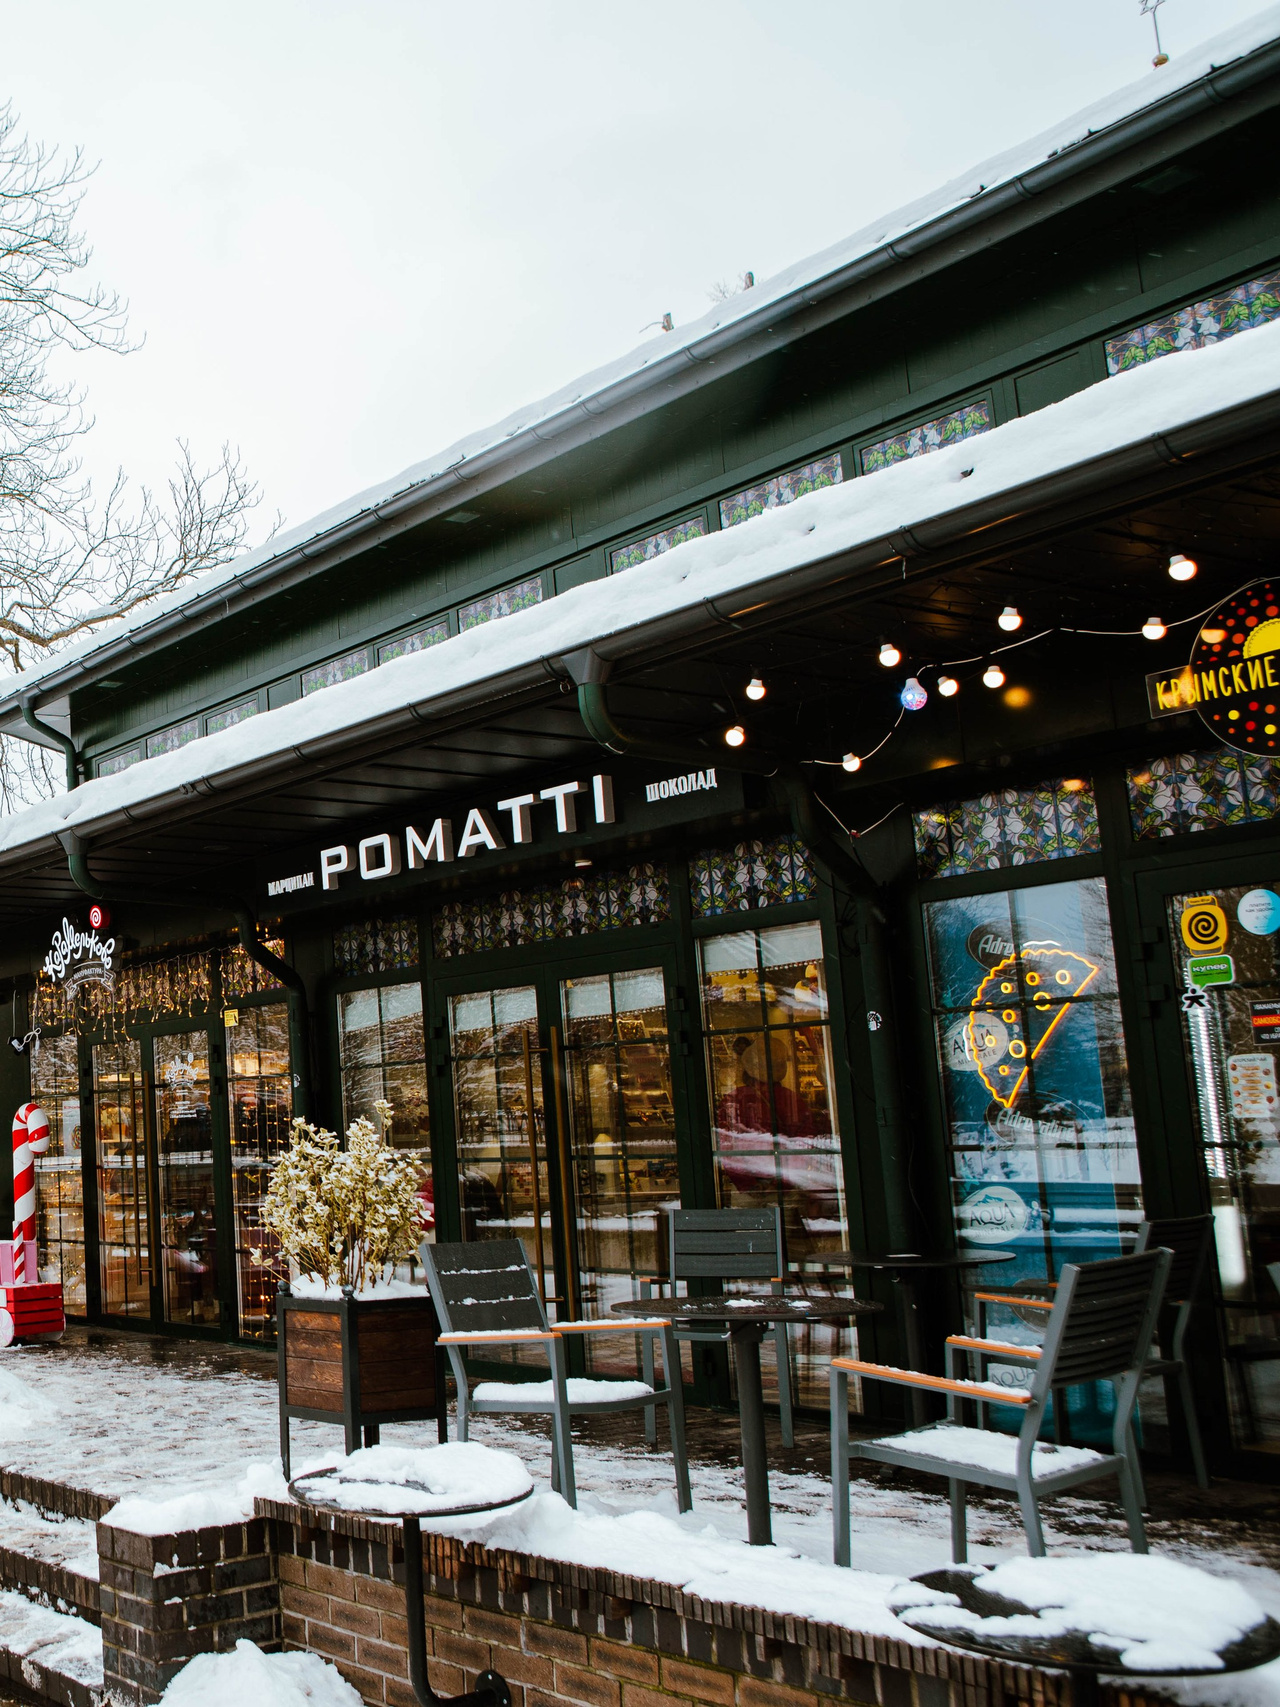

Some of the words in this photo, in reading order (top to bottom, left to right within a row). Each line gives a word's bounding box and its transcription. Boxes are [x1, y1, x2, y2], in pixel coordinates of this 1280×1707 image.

[1156, 656, 1280, 710] КРЫМСКИЕ
[267, 871, 315, 896] МАРЦИПАН
[320, 774, 615, 890] POMATTI
[645, 768, 718, 802] ШОКОЛАД
[970, 1202, 1016, 1227] AQUA
